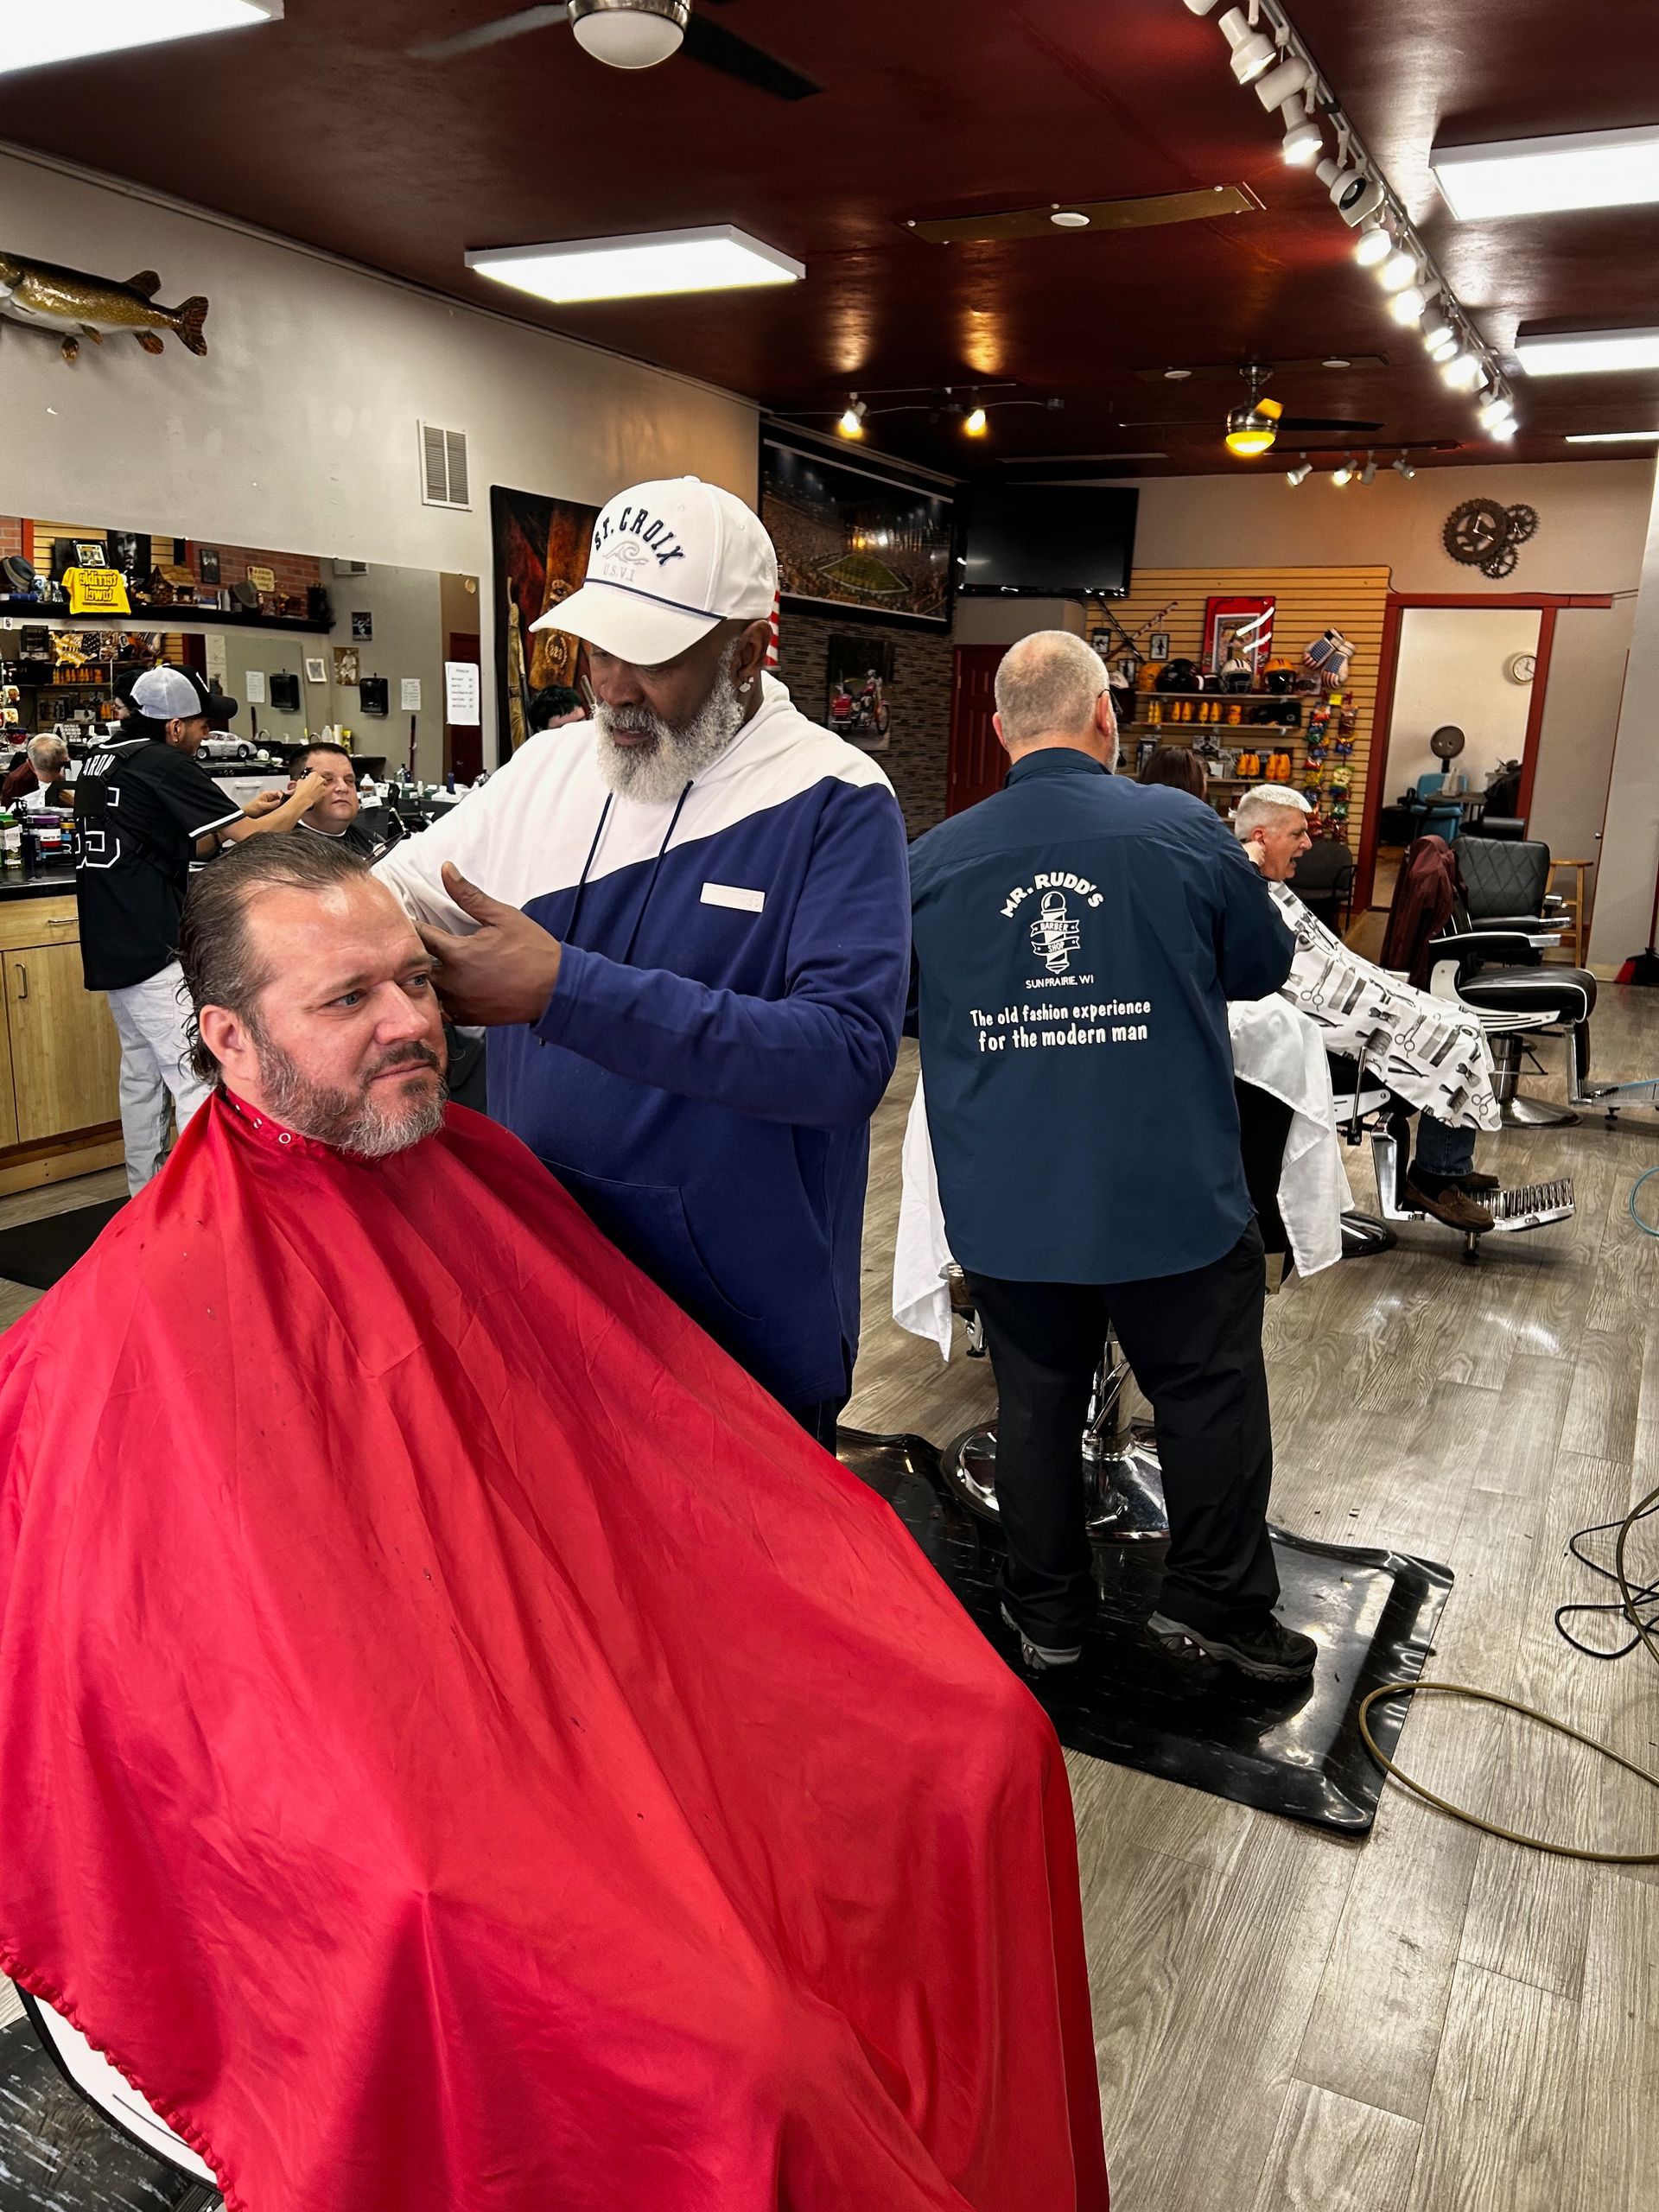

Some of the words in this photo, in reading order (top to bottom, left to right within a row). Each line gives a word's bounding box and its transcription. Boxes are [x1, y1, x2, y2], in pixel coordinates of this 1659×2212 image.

[594, 517, 614, 550] ST.
[620, 507, 683, 565] CROIX
[1000, 887, 1033, 918] MR.
[1034, 871, 1104, 908] RUDD'S
[1039, 922, 1068, 931] BARBER
[1047, 941, 1065, 952] SHOP
[1025, 979, 1045, 989] SUN
[1078, 974, 1094, 984] WI
[969, 1009, 994, 1027] The
[997, 1006, 1019, 1025] old
[1022, 1003, 1068, 1022] fashion
[1072, 999, 1151, 1022] experience
[978, 1031, 1006, 1052] for
[1012, 1026, 1038, 1048] the
[1041, 1022, 1106, 1046] modern
[1111, 1025, 1148, 1042] man
